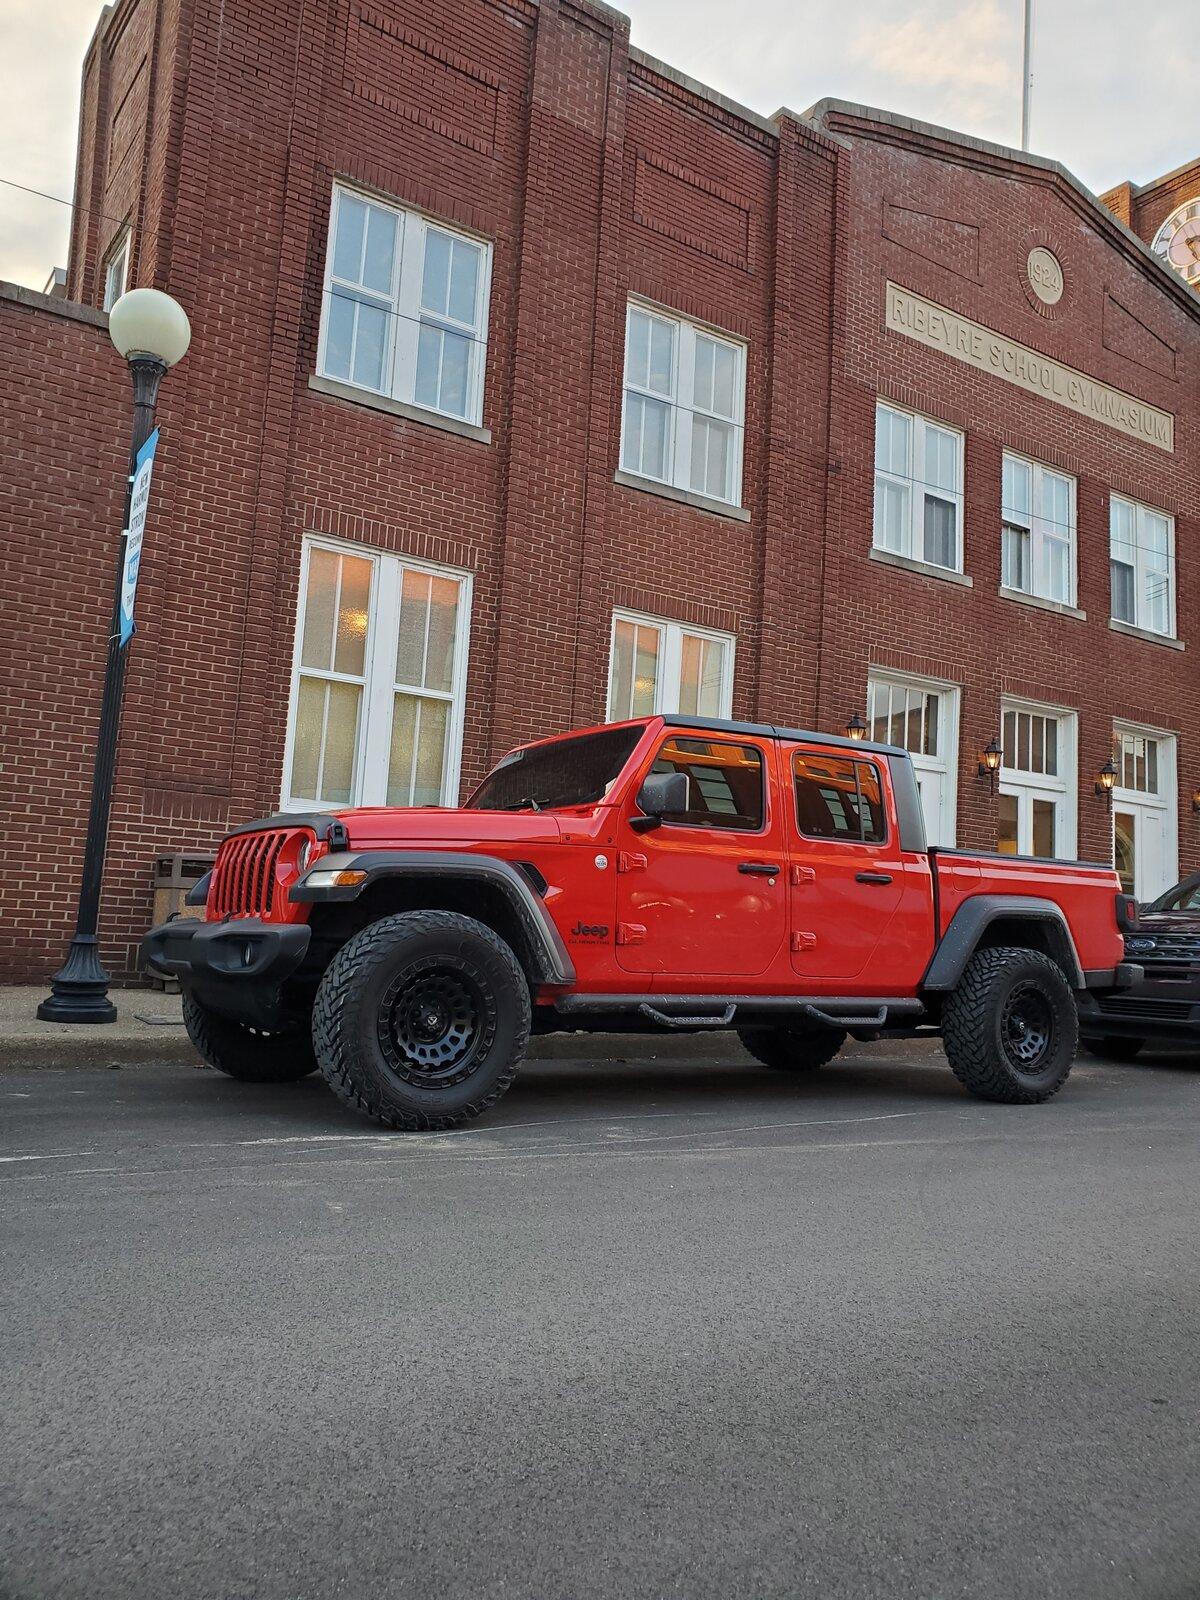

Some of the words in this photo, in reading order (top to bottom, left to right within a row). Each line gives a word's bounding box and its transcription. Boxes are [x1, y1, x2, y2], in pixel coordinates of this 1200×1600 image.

[1029, 261, 1060, 293] 1924
[892, 294, 983, 360] RIBEYRE
[989, 344, 1062, 397] SCHOOL
[1066, 378, 1168, 444] GYMNASIUM
[571, 920, 609, 939] Jeep
